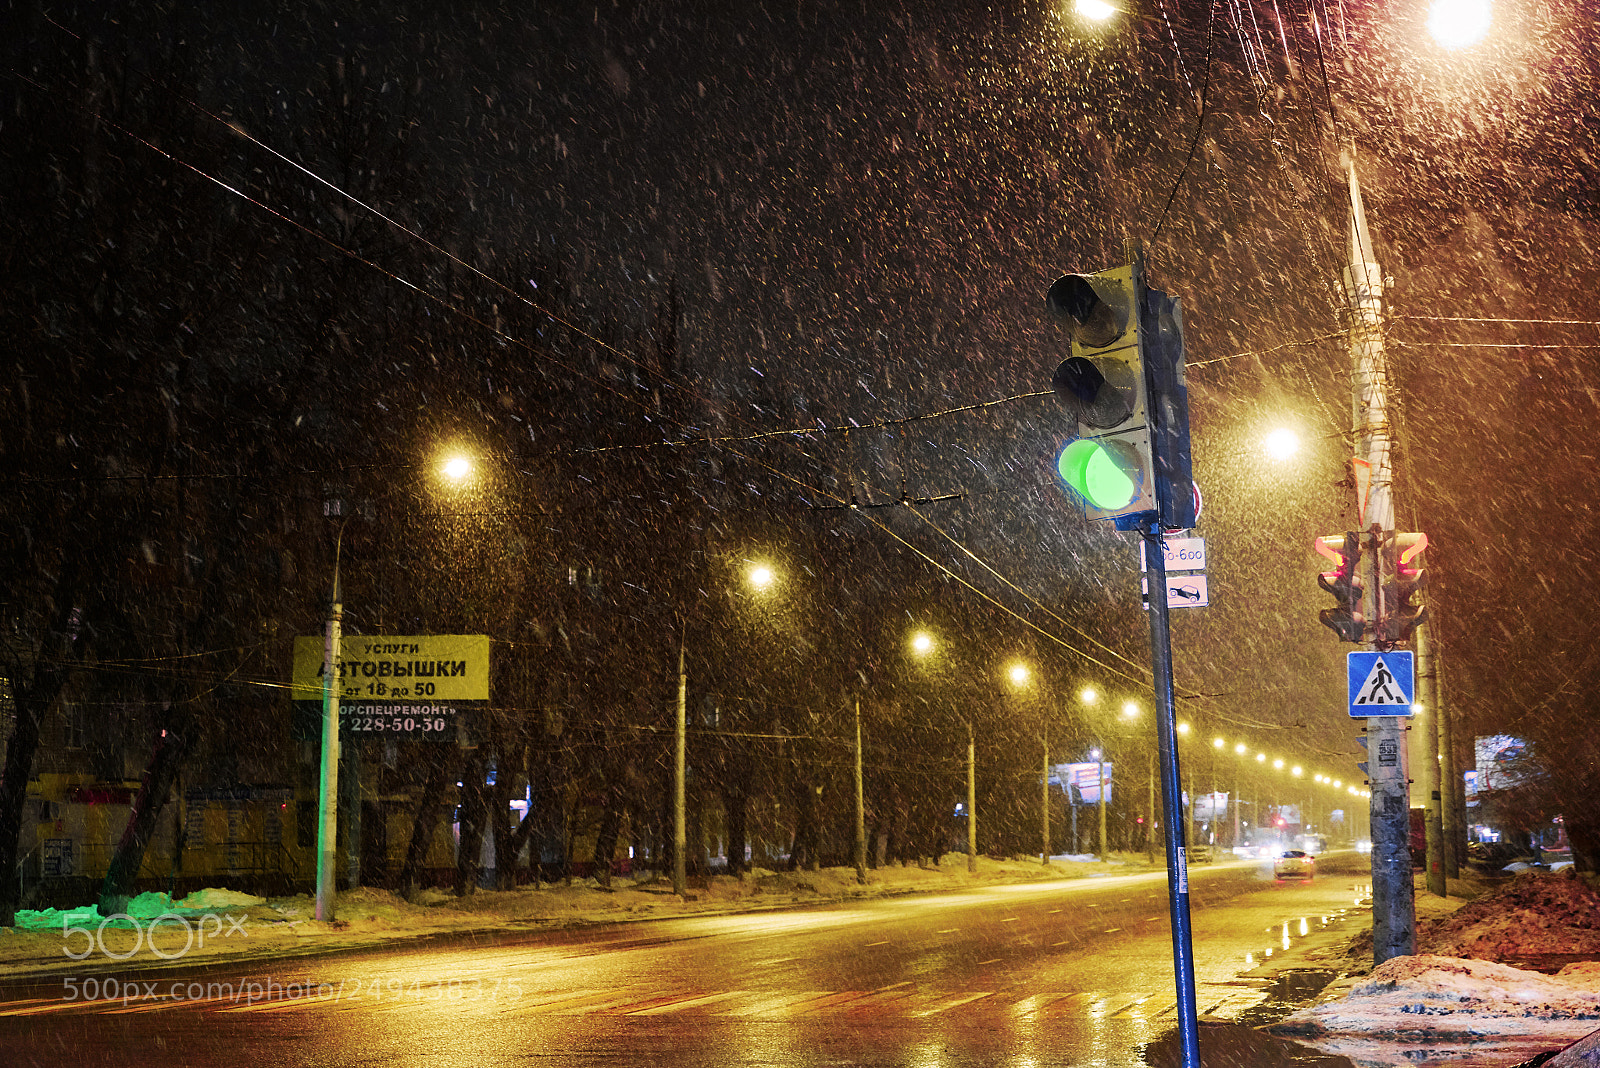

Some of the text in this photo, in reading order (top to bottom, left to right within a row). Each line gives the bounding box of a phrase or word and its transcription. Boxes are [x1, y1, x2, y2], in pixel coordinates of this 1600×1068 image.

[364, 643, 419, 655] УСЛУГИ
[367, 683, 386, 696] 18
[391, 687, 409, 699] до
[415, 683, 435, 696] 50
[339, 705, 456, 716] ОРСПЕЦРЕМОНТ»
